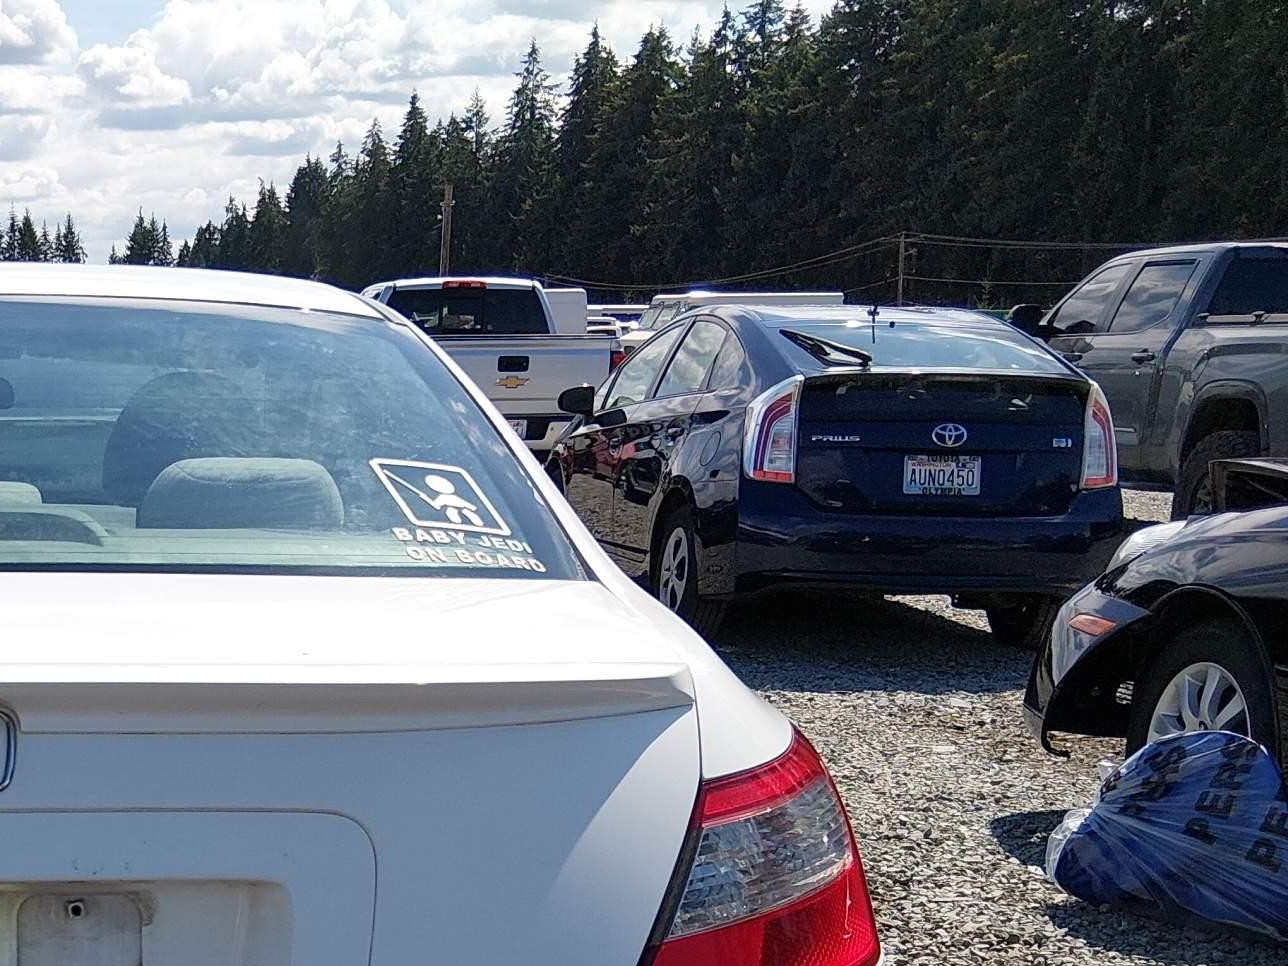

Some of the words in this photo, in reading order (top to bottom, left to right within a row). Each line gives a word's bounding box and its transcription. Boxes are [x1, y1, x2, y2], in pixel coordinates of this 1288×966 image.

[392, 527, 467, 545] BABY
[478, 534, 533, 554] JEDI
[406, 546, 448, 563] ON
[455, 549, 547, 573] BOARD
